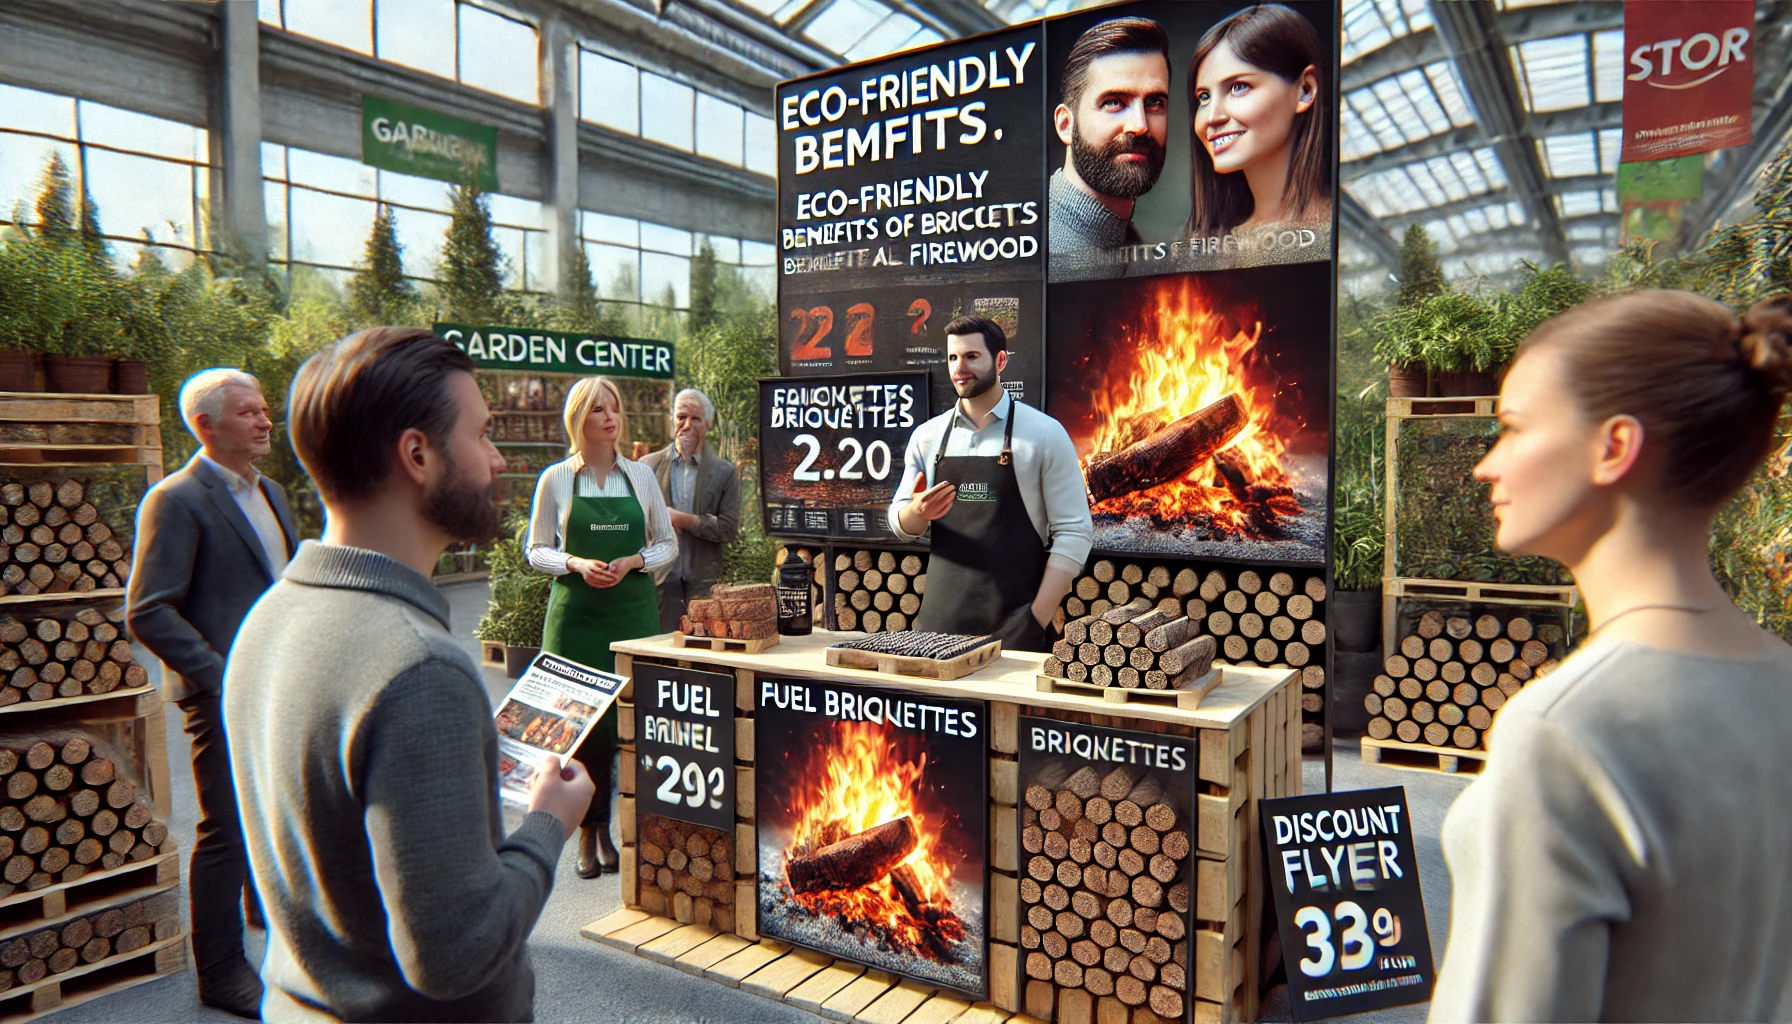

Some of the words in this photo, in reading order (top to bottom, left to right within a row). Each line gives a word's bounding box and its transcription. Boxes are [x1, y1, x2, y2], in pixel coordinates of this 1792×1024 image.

[1627, 27, 1750, 82] STOR
[782, 41, 1037, 131] ECO-FRIENDLY
[797, 169, 990, 221] ECO-FRIENDLY
[885, 213, 915, 238] OF
[908, 234, 1039, 267] FIREWOOD
[444, 329, 567, 364] GARDEN
[575, 339, 671, 373] CENTER
[792, 433, 892, 482] 2.20
[657, 679, 720, 717] FUEL
[760, 680, 818, 714] FUEL
[1272, 804, 1401, 846] DISCOUNT
[1280, 839, 1404, 896] FLYER
